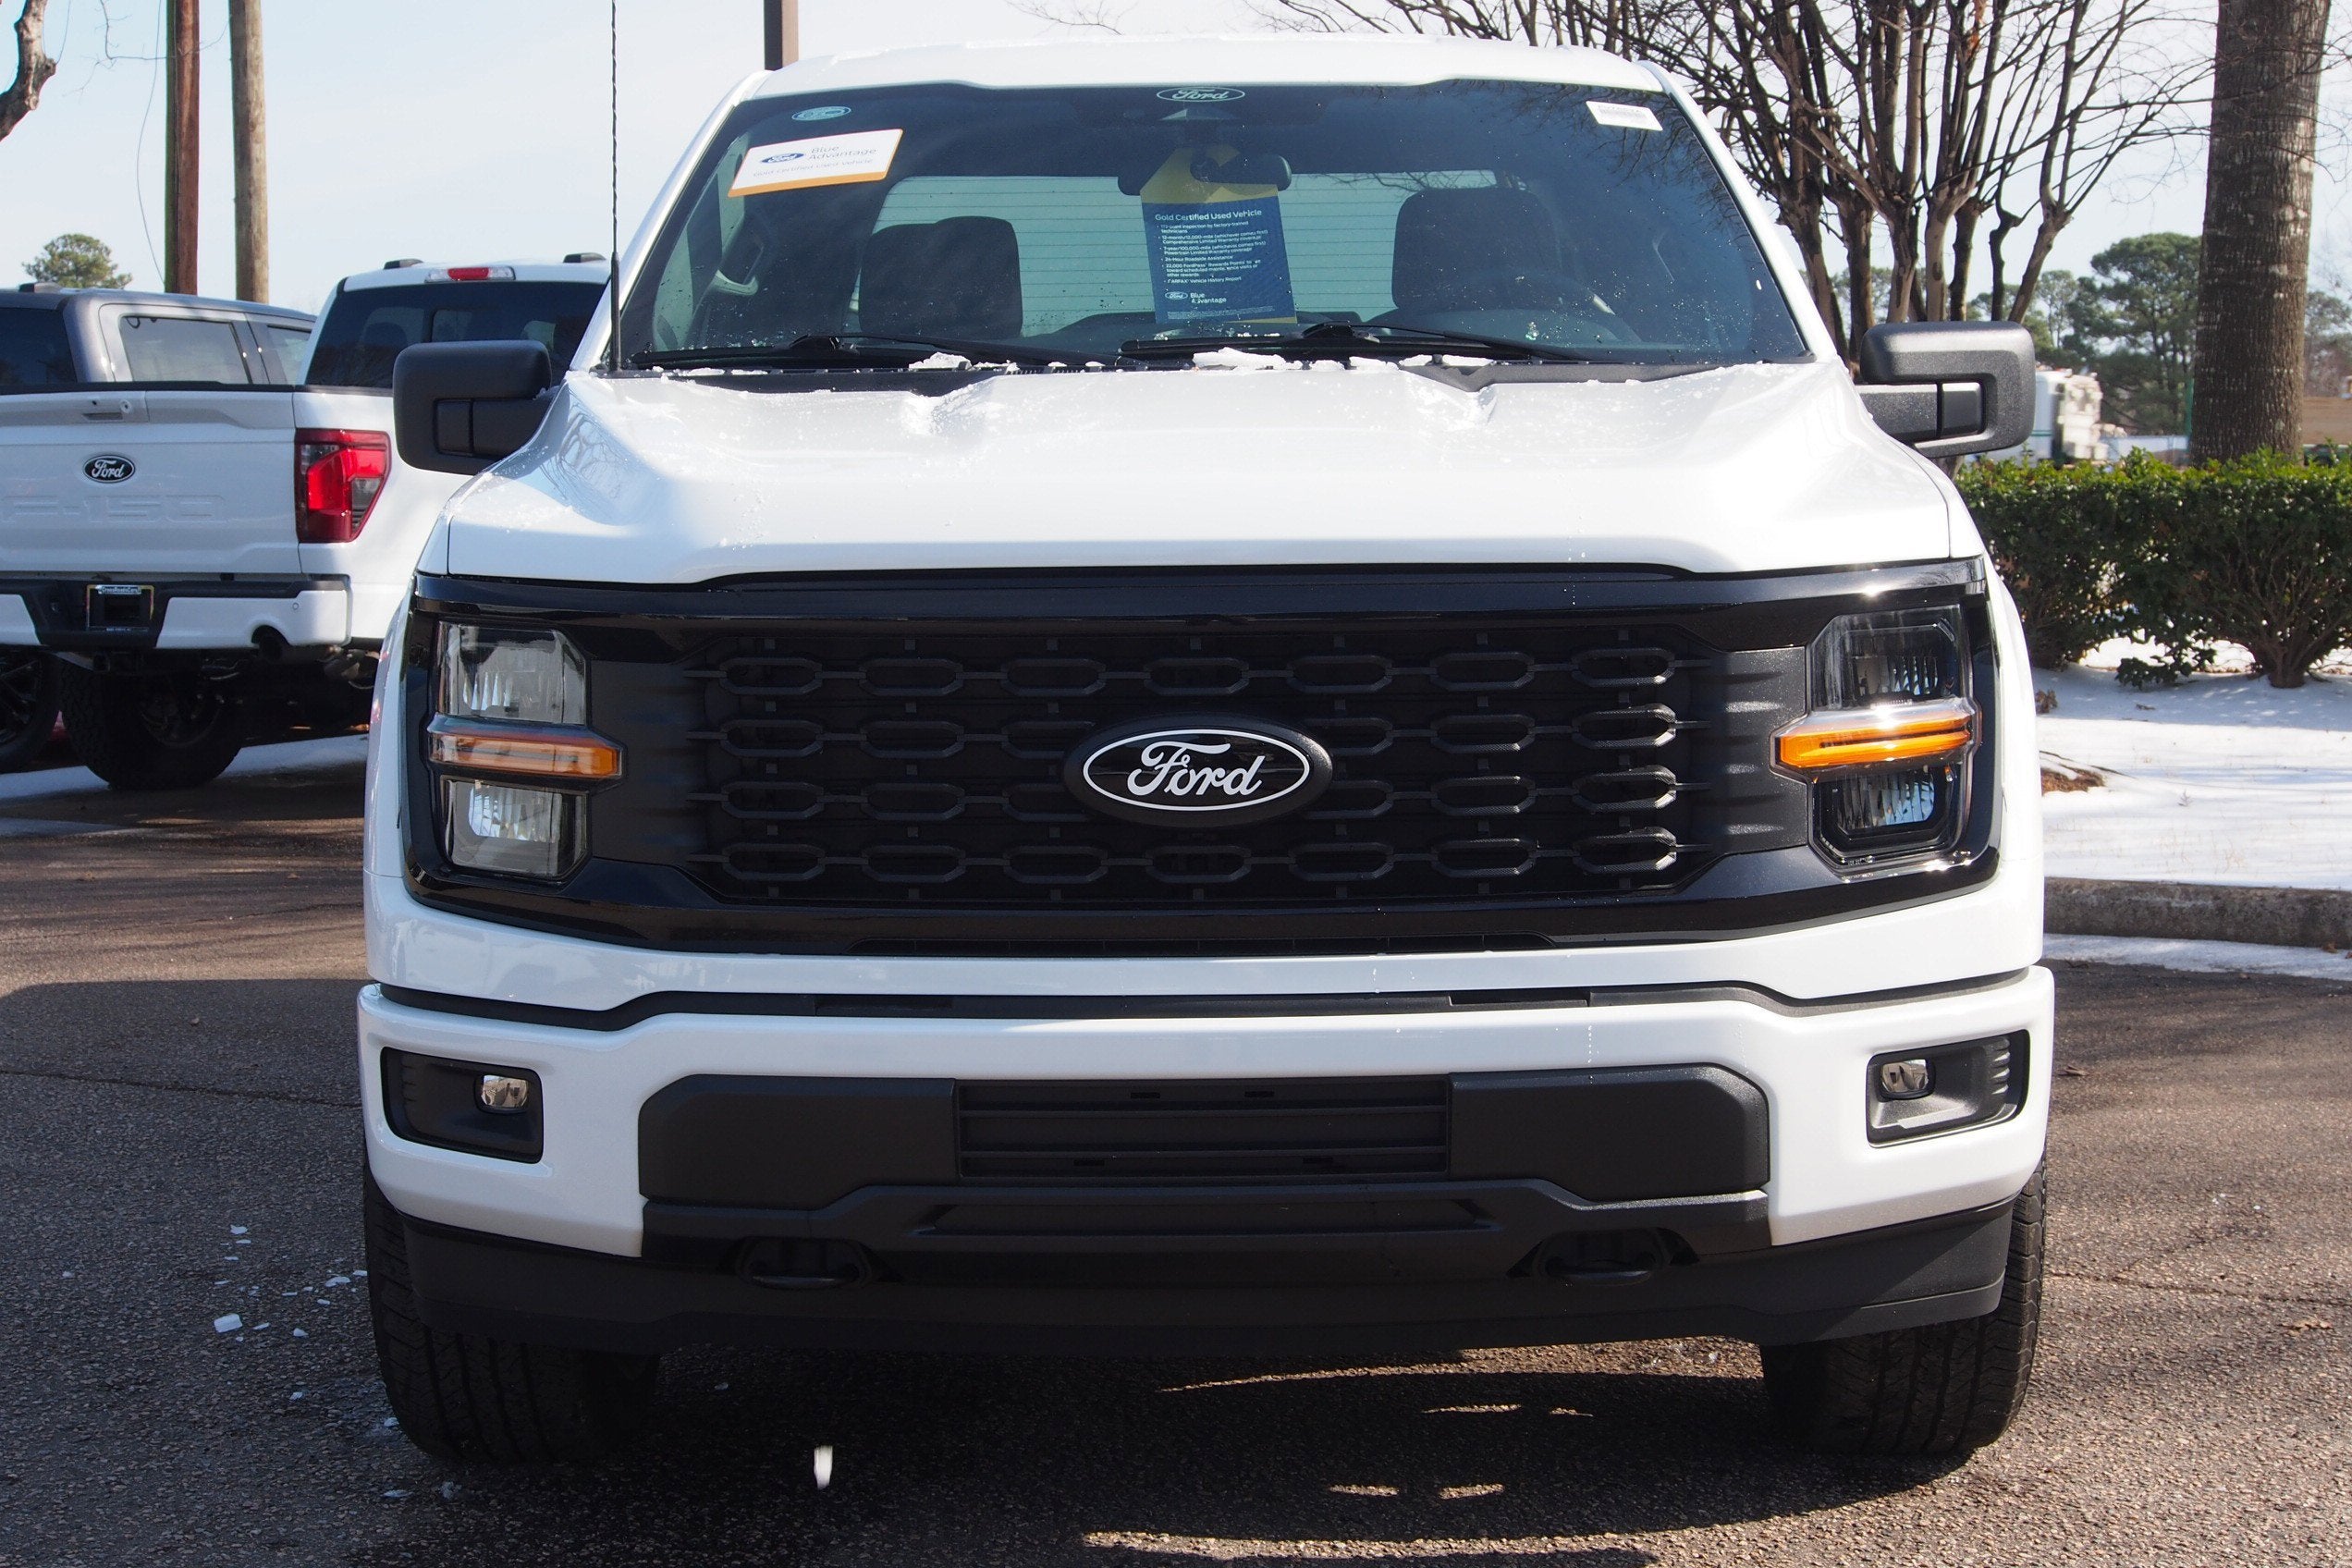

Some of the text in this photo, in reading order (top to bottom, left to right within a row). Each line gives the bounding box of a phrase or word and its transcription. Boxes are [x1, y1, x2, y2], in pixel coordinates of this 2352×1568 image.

[1171, 88, 1230, 99] Ford
[807, 148, 876, 161] Advantage
[811, 145, 839, 153] Blue
[1232, 210, 1262, 218] Vehicle
[92, 459, 125, 478] Ford
[1127, 741, 1266, 796] Ford
